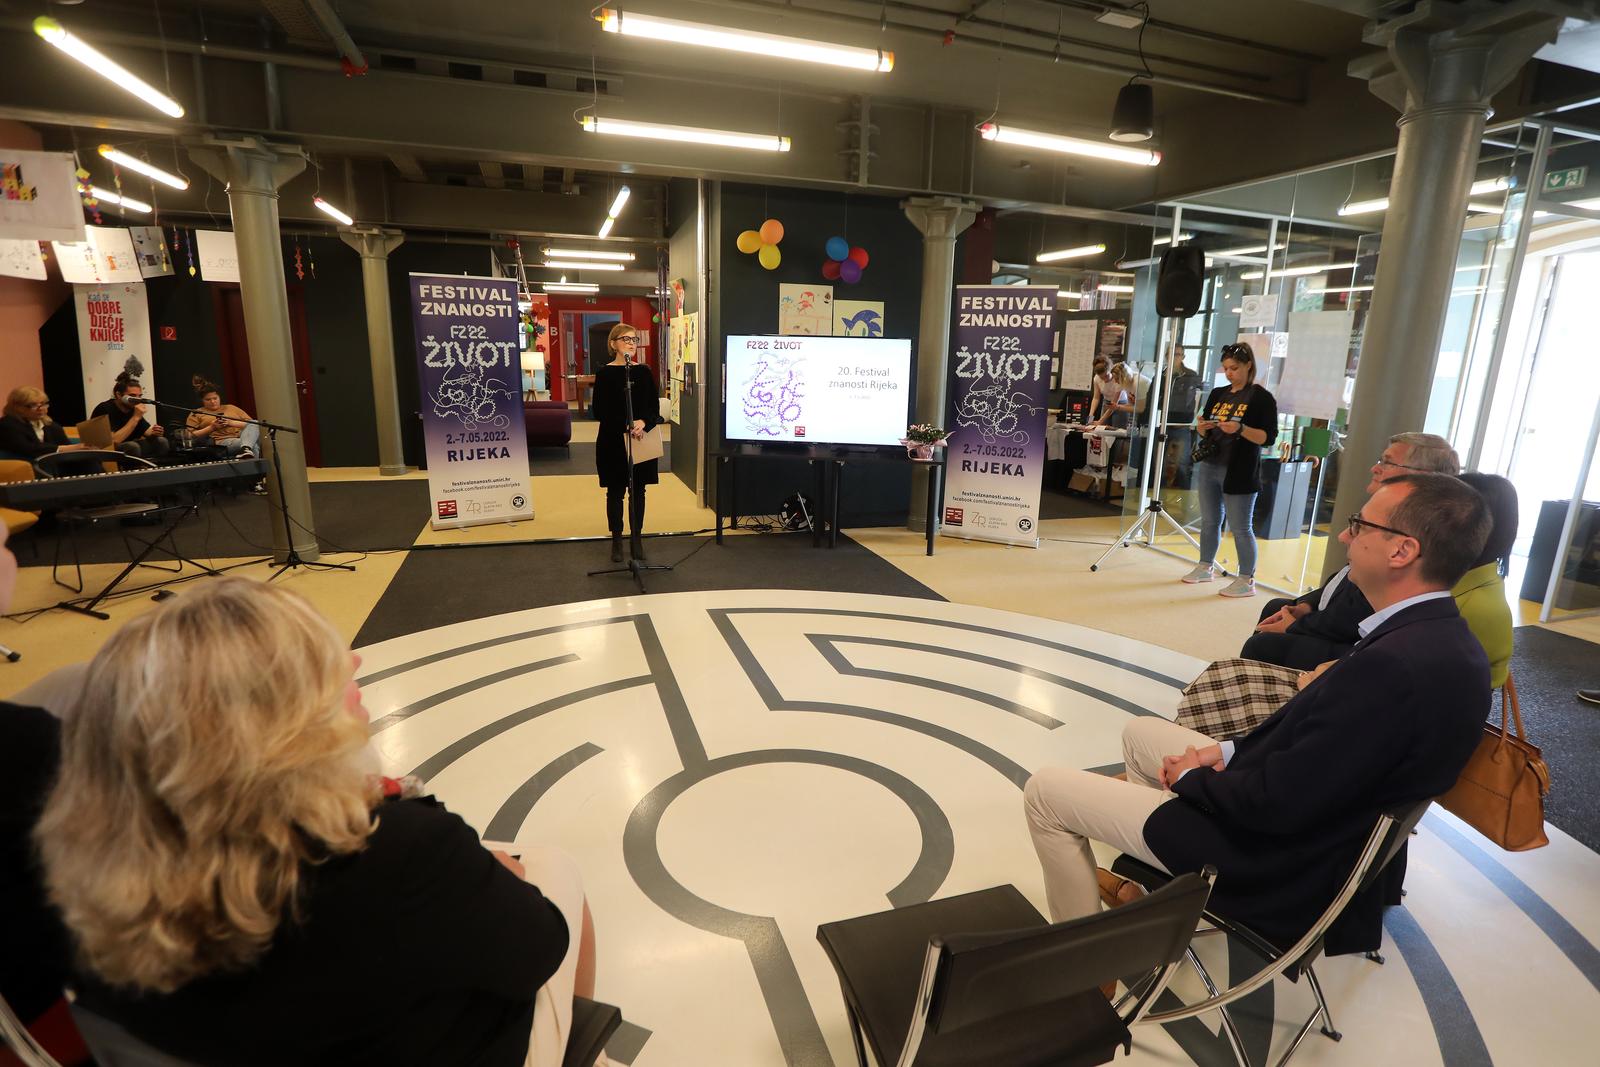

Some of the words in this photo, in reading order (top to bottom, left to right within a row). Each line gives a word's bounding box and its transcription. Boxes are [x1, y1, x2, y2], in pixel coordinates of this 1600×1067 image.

[420, 285, 512, 301] FESTIVAL
[87, 301, 122, 314] DOBRE
[420, 302, 513, 317] ZNANOSTI
[961, 296, 1053, 311] FESTIVAL
[959, 313, 1051, 329] ZNANOSTI
[89, 328, 125, 342] KNJIGE
[422, 335, 516, 368] ŽIVOT
[773, 339, 803, 351] ŽIVOT
[956, 345, 1050, 381] ŽIVOT
[837, 366, 852, 376] 20.
[855, 366, 890, 377] Festival
[828, 379, 869, 389] znanosti
[870, 380, 898, 391] Rijeka
[447, 446, 511, 462] RIJEKA
[962, 460, 1025, 477] RIJEKA
